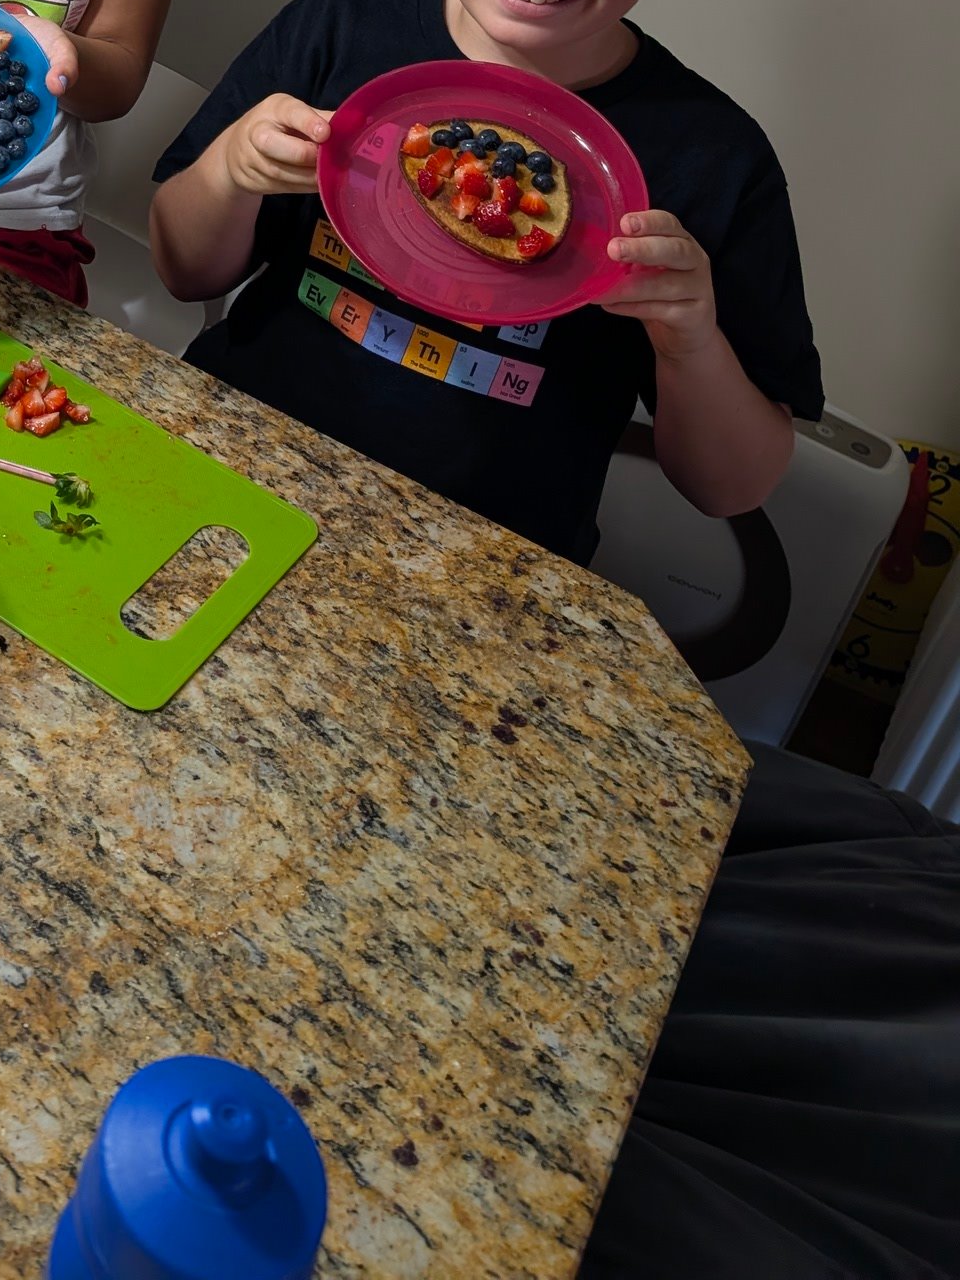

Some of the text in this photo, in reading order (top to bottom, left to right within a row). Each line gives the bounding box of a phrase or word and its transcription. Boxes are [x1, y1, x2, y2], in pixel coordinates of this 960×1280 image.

[323, 233, 343, 256] Th
[306, 283, 327, 307] Ev
[341, 303, 361, 326] Er
[382, 325, 397, 343] Y
[419, 340, 441, 365] Th
[469, 361, 479, 378] I
[501, 371, 530, 396] Ng
[847, 633, 872, 660] 6
